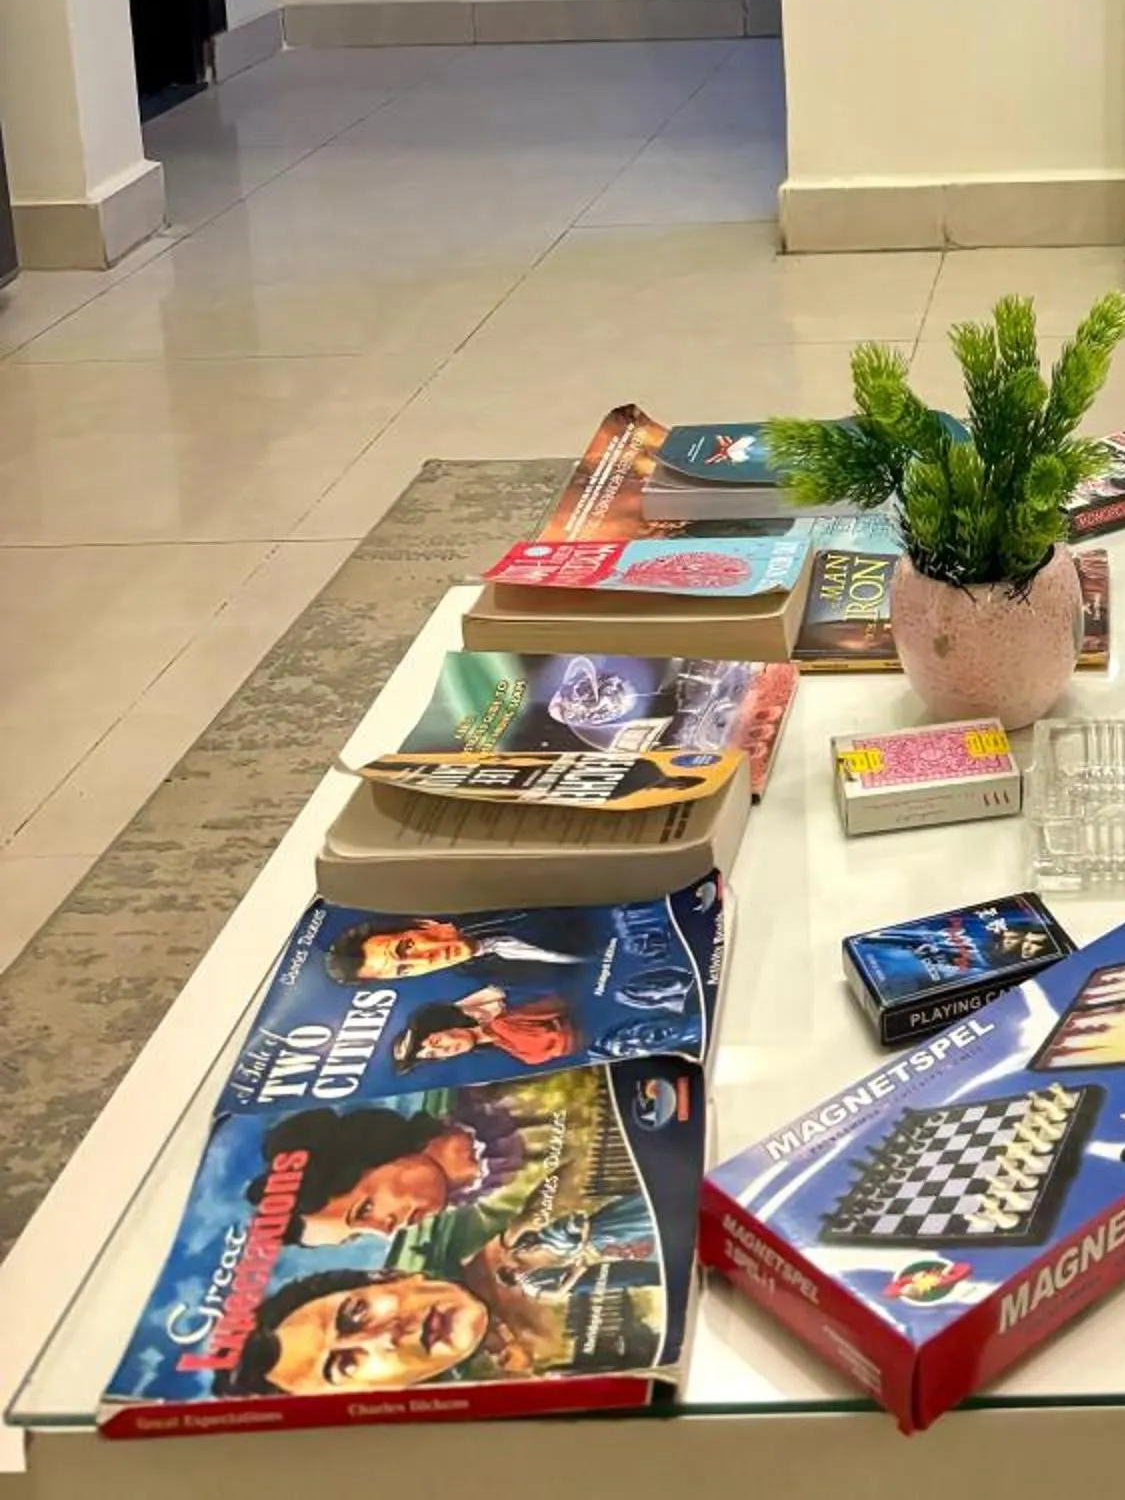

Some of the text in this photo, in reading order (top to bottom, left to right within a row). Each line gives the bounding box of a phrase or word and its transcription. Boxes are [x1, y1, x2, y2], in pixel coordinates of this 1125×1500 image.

[821, 555, 851, 601] MAN
[847, 559, 888, 622] IRON
[312, 987, 397, 1101] CITIES
[911, 992, 981, 1027] PLAYING
[258, 1025, 333, 1103] TWO
[767, 1015, 996, 1161] MAGNETSPEL
[167, 1224, 246, 1345] Great
[723, 1214, 819, 1304] MAGNETSPEL
